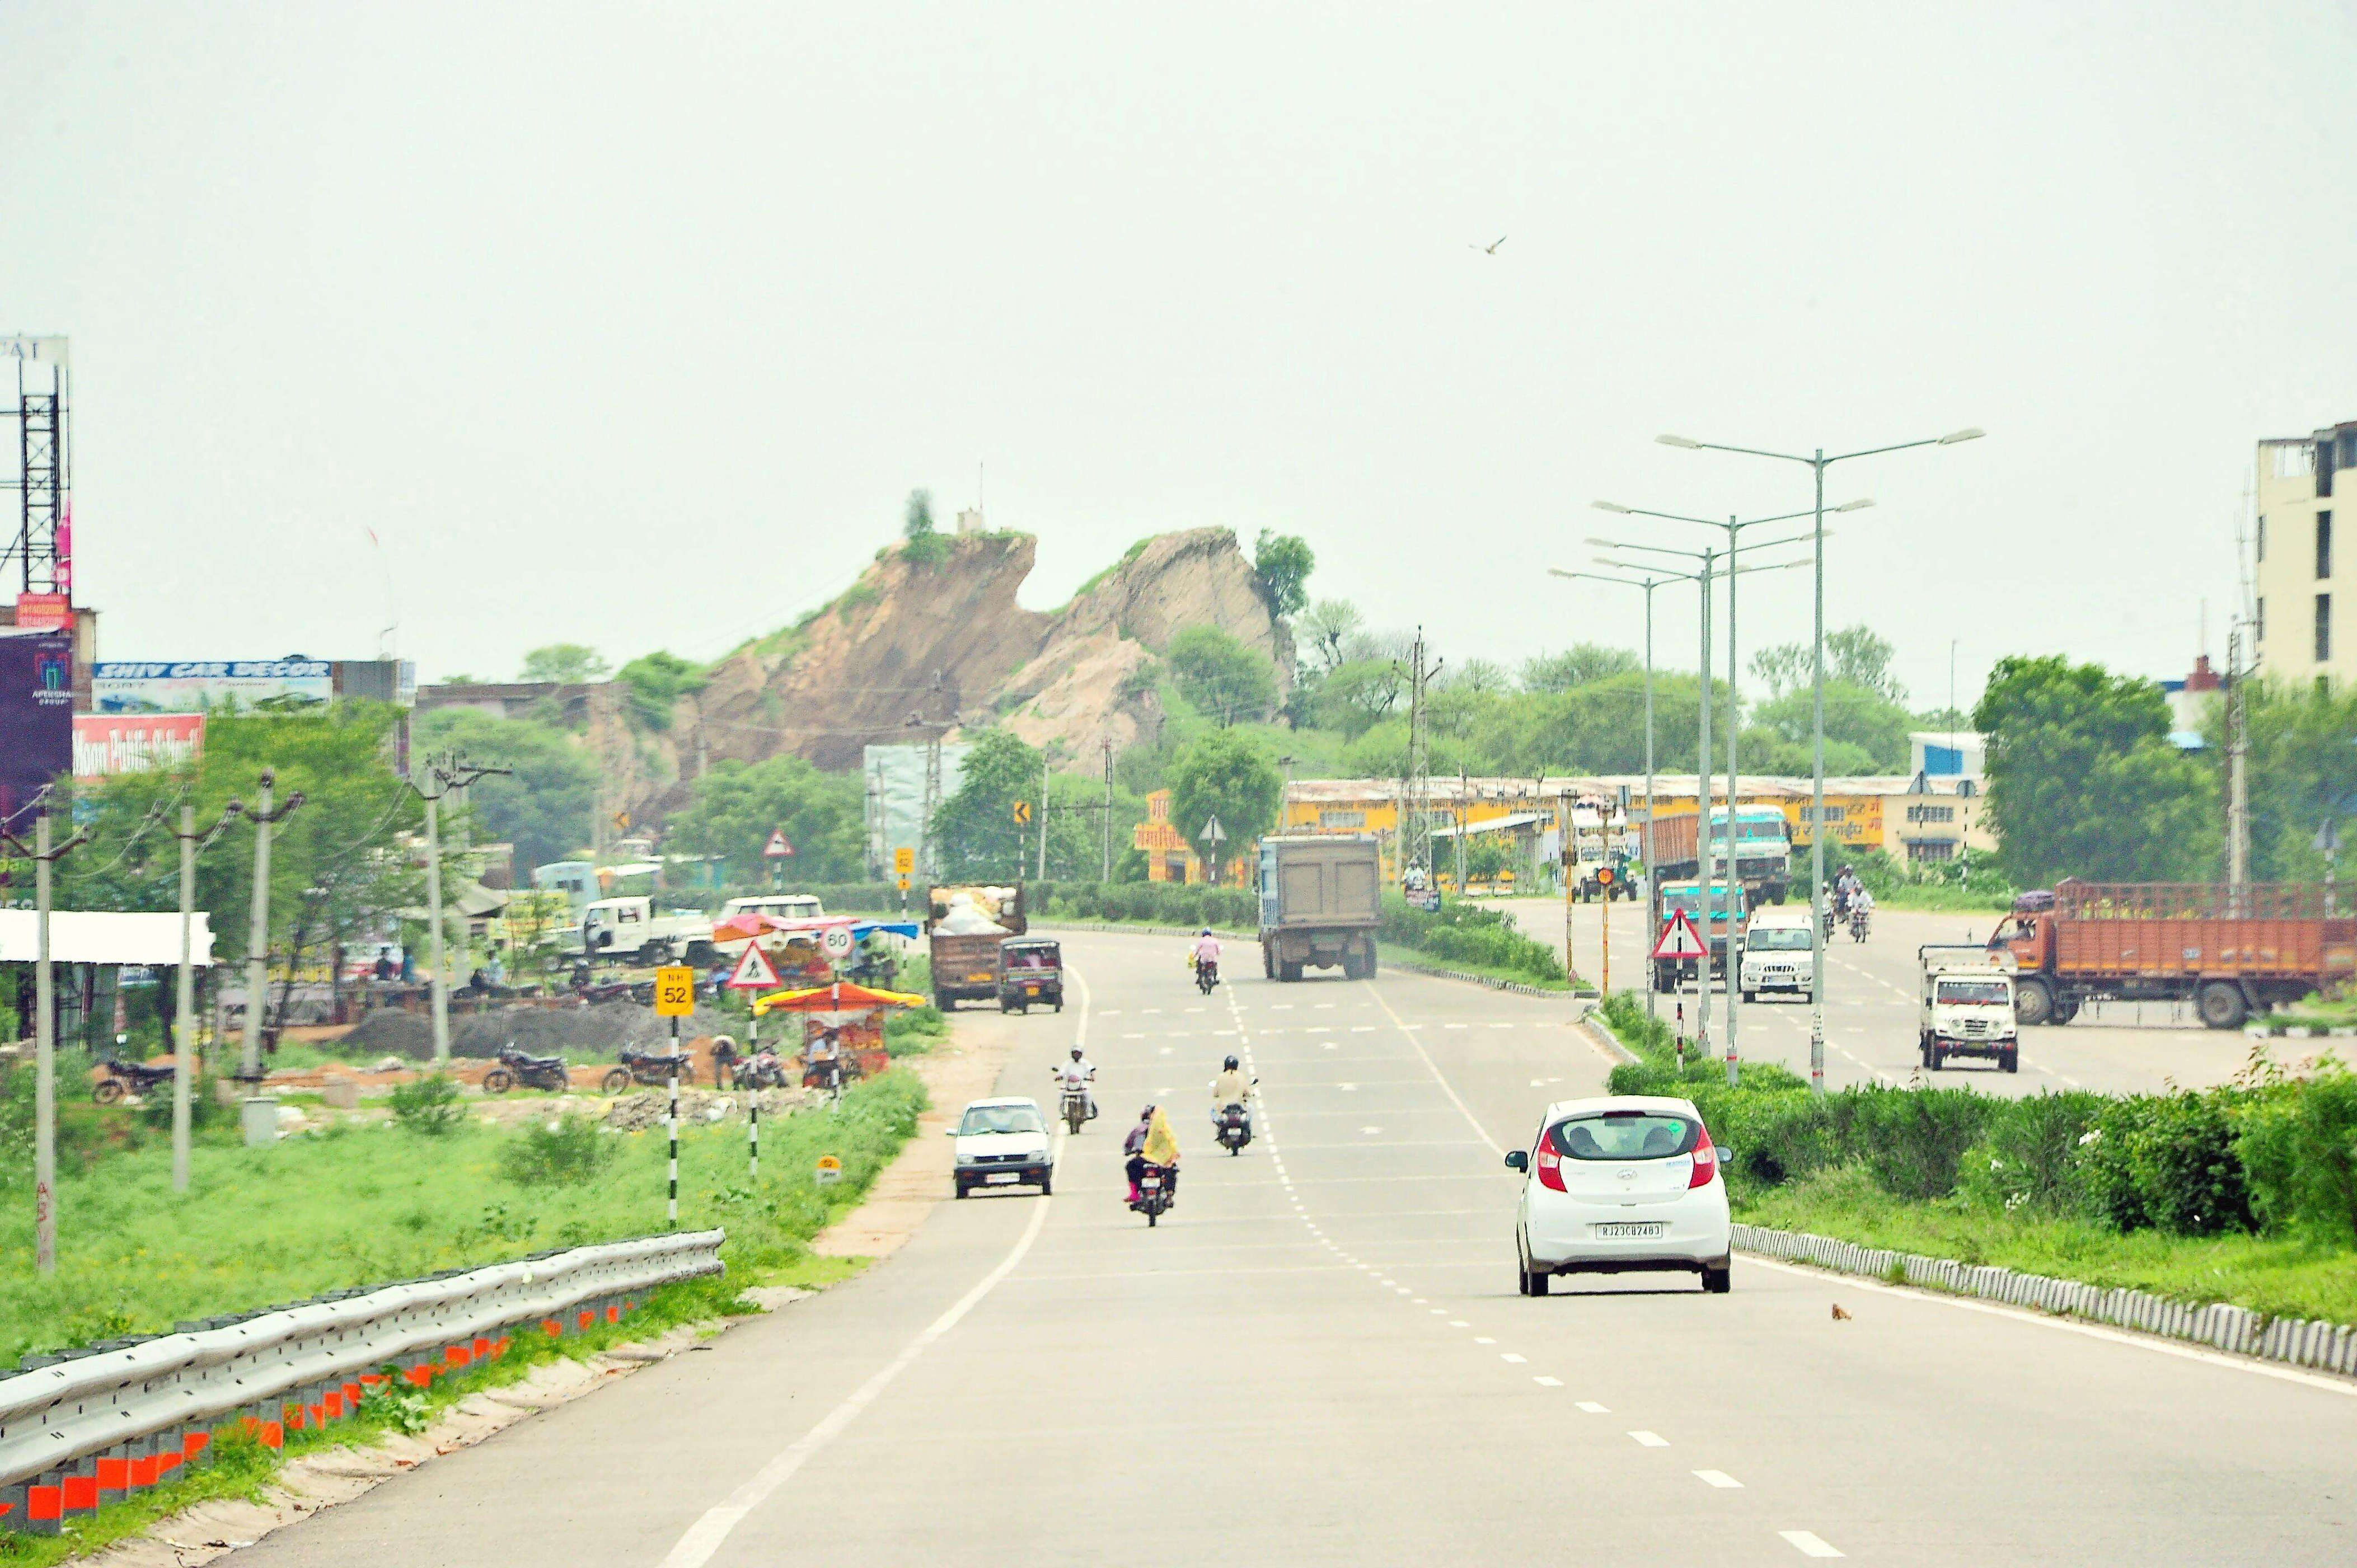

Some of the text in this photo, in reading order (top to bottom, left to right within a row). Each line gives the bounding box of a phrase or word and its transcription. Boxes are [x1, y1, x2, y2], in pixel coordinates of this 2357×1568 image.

[97, 662, 329, 678] SHIV CAR DECOR
[664, 987, 686, 1003] 52
